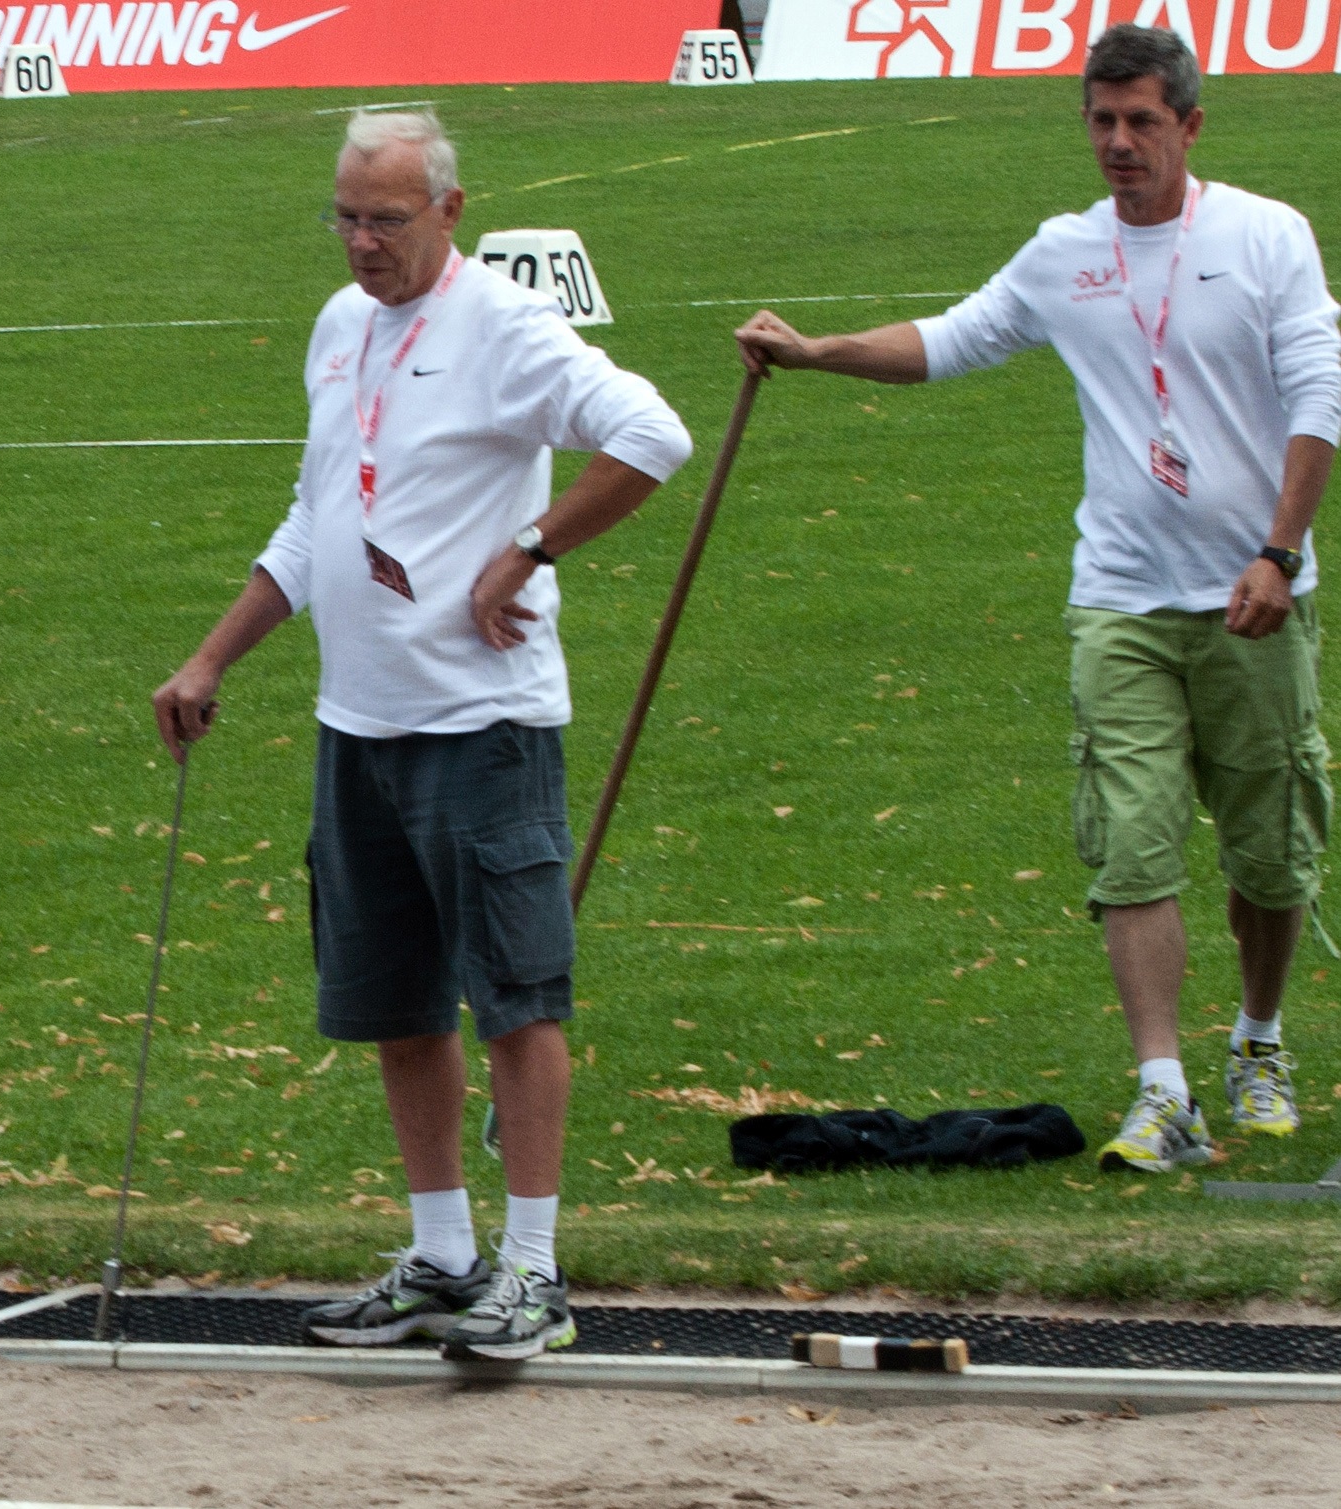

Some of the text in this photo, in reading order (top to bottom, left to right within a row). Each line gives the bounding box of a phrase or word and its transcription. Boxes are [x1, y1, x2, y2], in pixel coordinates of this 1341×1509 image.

[16, 55, 53, 92] 60
[700, 41, 738, 79] 55
[549, 250, 594, 318] 50
